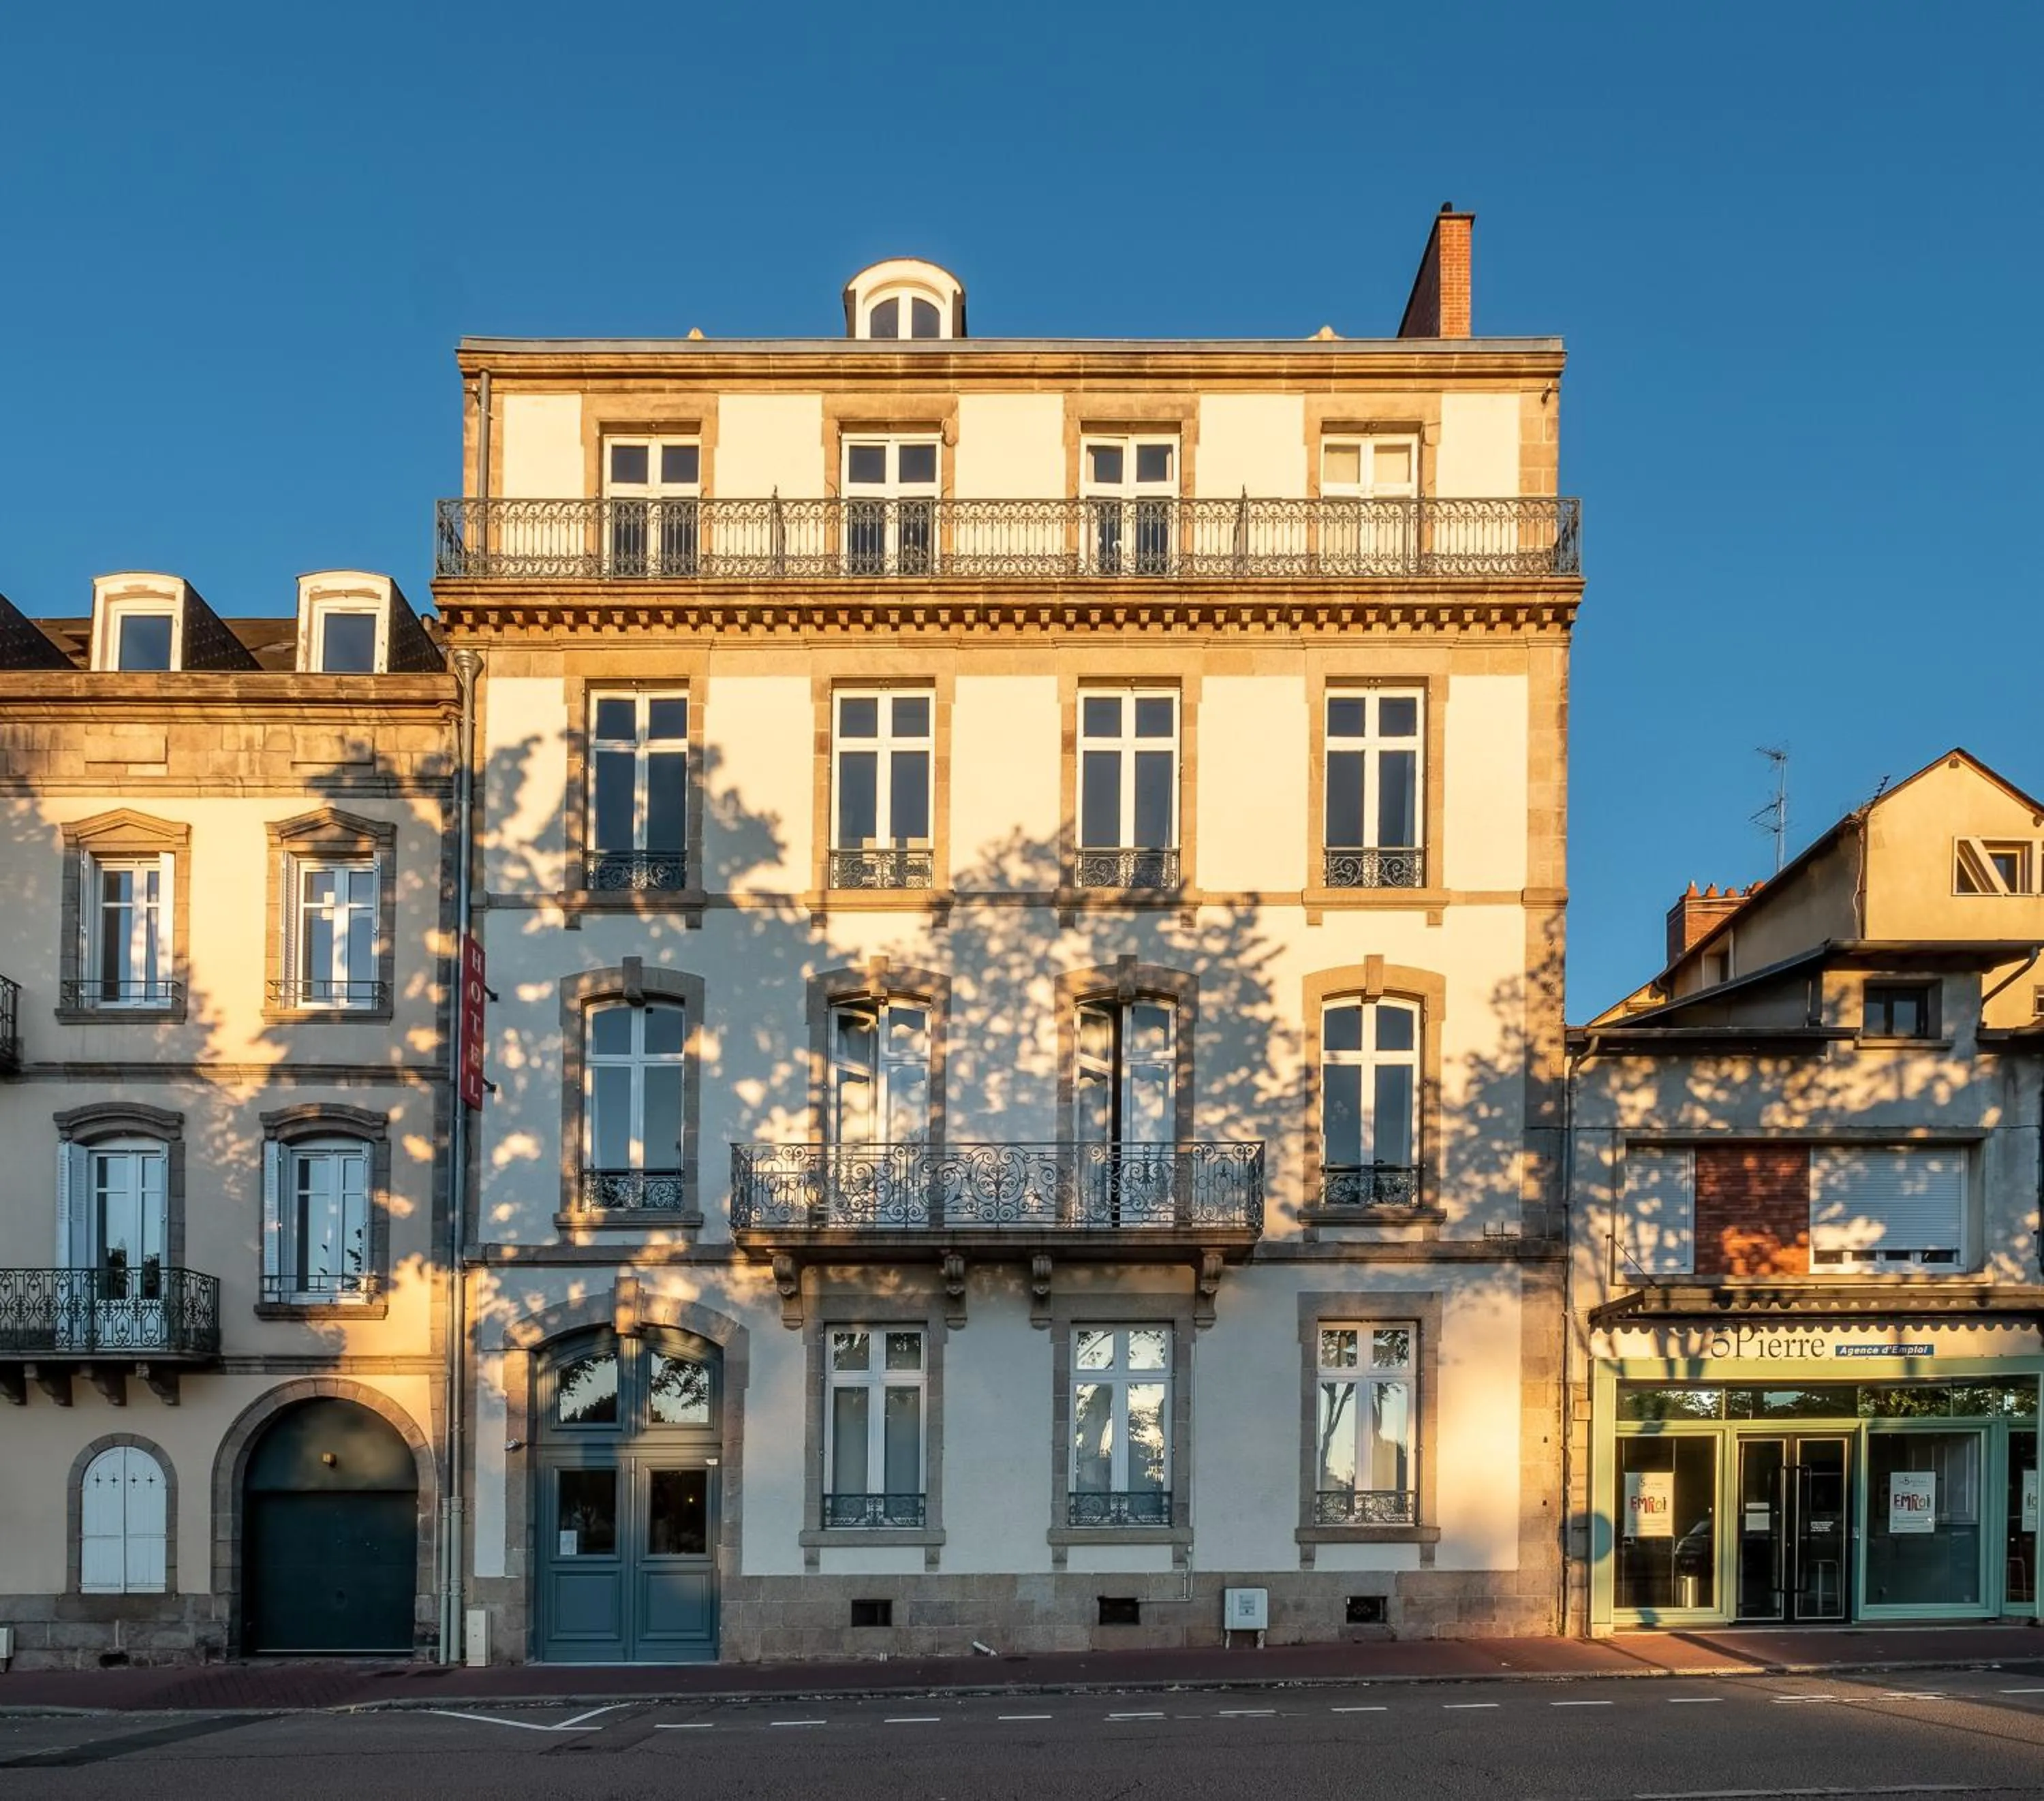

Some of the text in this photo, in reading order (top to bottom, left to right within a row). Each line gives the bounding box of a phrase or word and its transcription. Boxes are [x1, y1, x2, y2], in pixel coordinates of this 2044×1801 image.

[469, 947, 482, 1101] HOTEL
[1839, 1345, 1928, 1356] Agence d'Emploi
